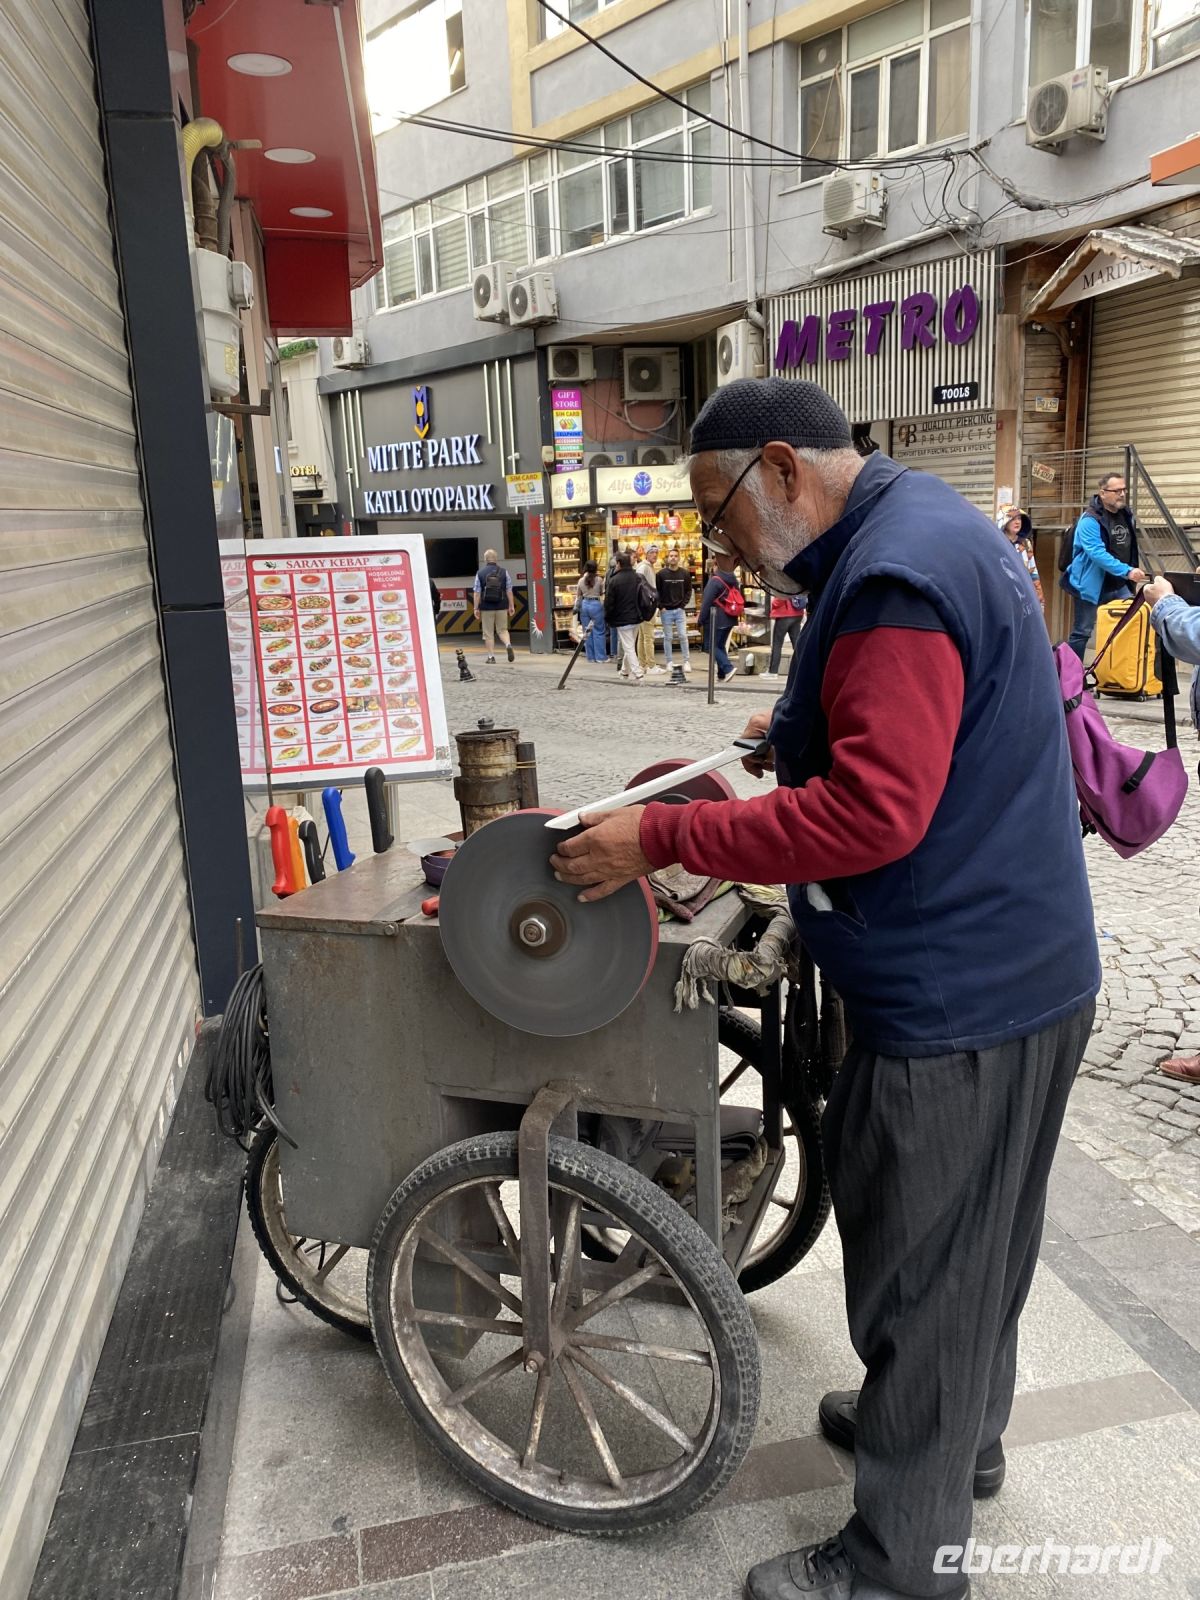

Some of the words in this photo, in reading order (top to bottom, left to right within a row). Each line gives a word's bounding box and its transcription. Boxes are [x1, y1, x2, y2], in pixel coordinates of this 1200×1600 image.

[775, 283, 980, 371] METRO
[557, 391, 576, 399] GIFT
[941, 386, 971, 400] TOOLS
[555, 400, 579, 408] STORE
[922, 419, 955, 432] QUALITY
[956, 413, 993, 427] PIERCING
[921, 427, 992, 445] PRODUCTS
[367, 440, 424, 473] MITTE
[426, 433, 483, 467] PARK
[655, 477, 683, 492] Style
[363, 489, 408, 514] KATLI
[410, 483, 496, 512] OTOPARK
[619, 516, 658, 525] UNLIMITED
[286, 558, 326, 569] SARAY
[330, 557, 370, 567] KEBAP
